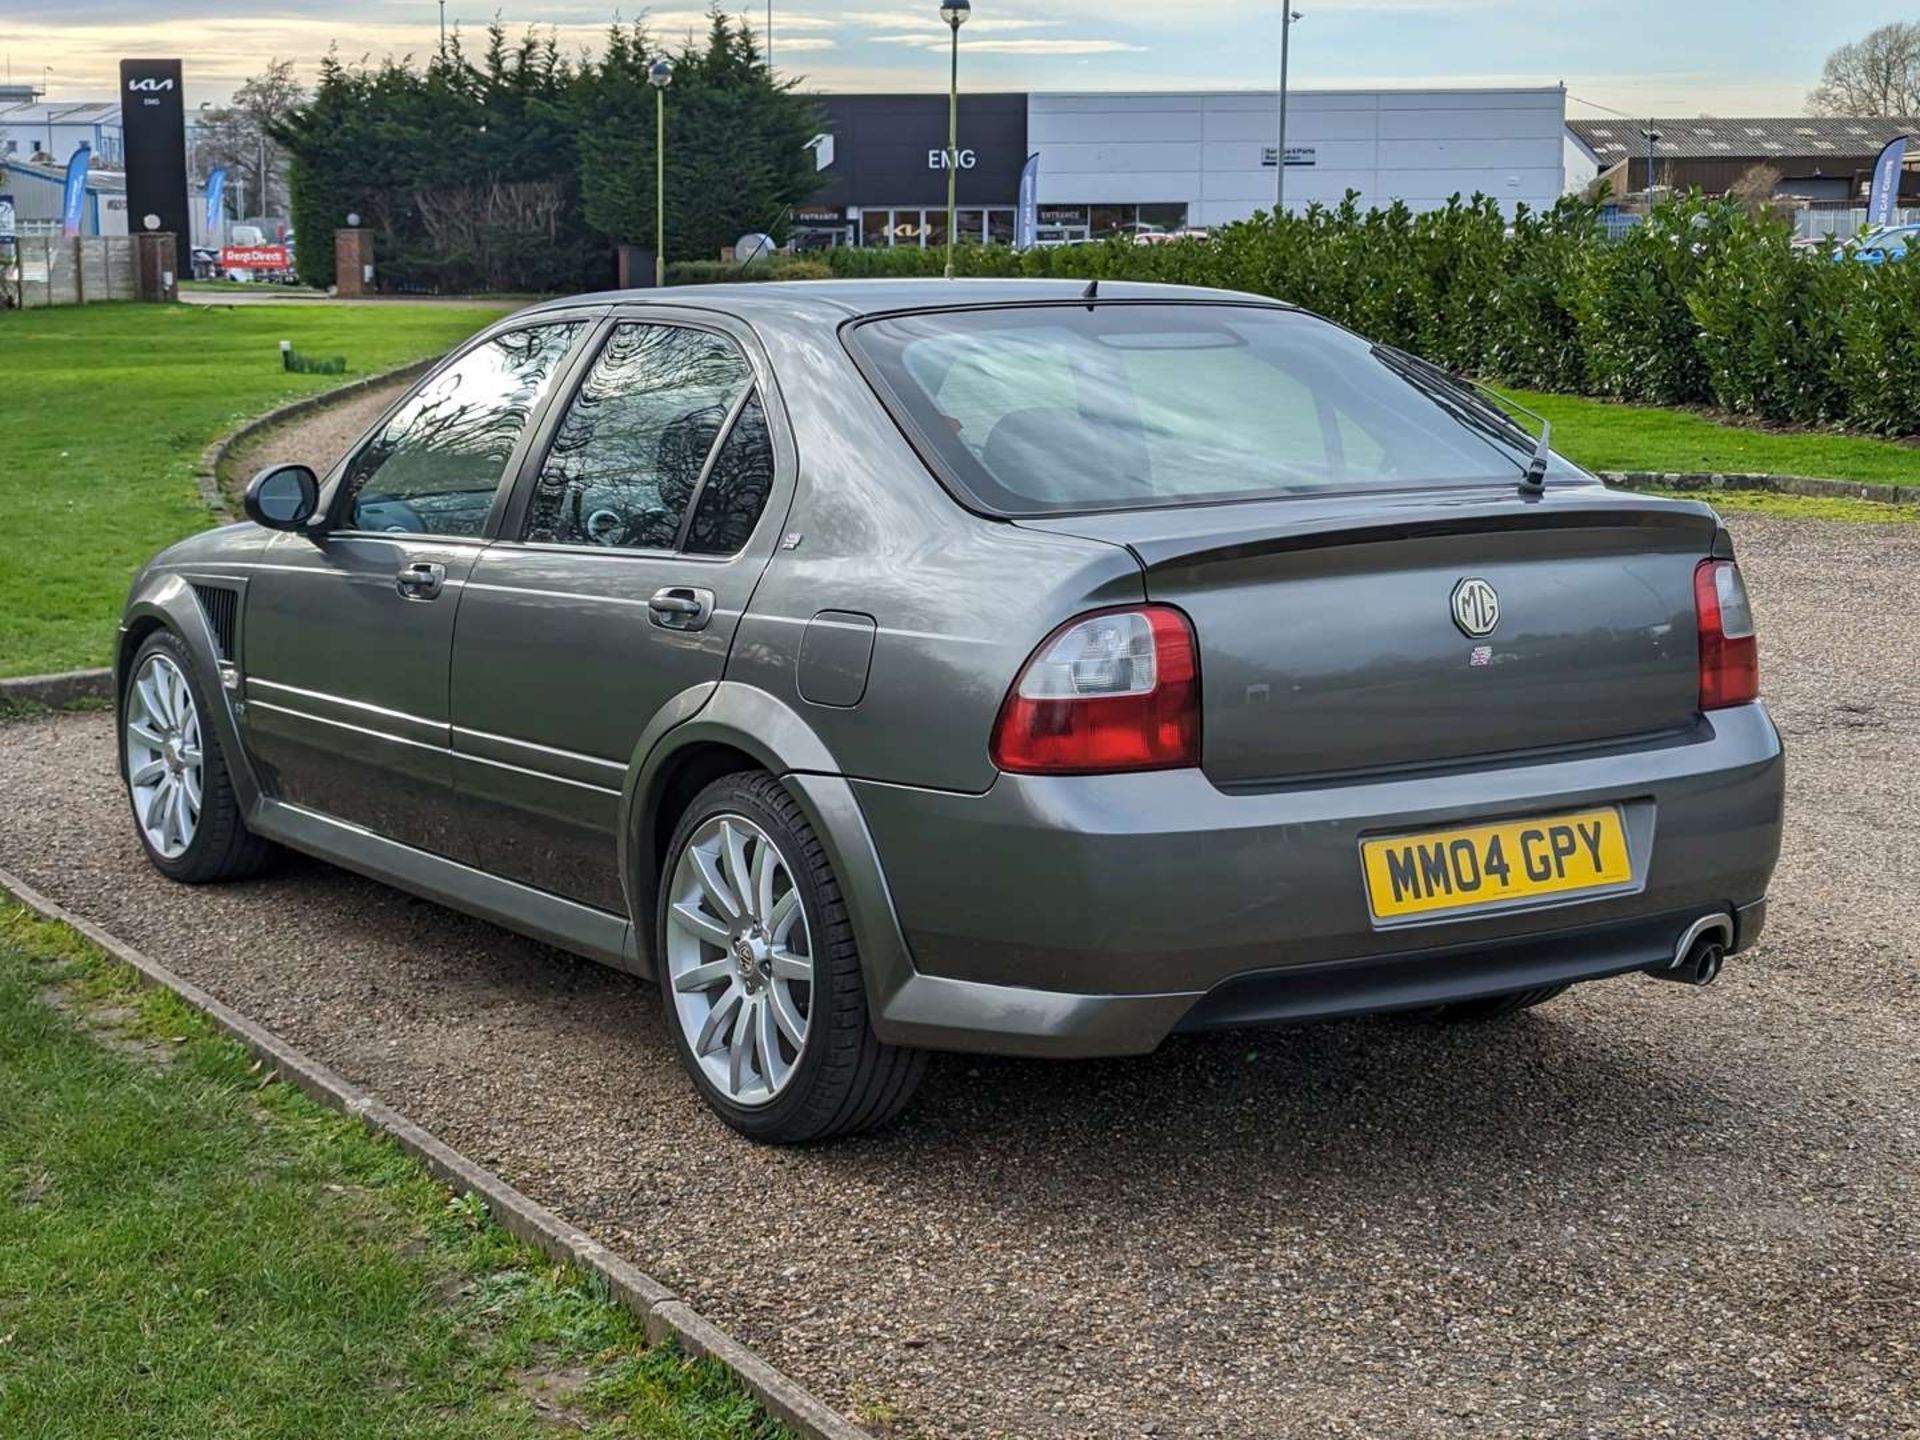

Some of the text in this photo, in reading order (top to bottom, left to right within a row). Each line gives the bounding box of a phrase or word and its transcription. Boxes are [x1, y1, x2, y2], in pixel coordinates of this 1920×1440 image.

[128, 78, 173, 91] KIA
[928, 149, 976, 169] EMG
[1461, 585, 1496, 628] MG
[1385, 820, 1603, 903] MM04 GPY
